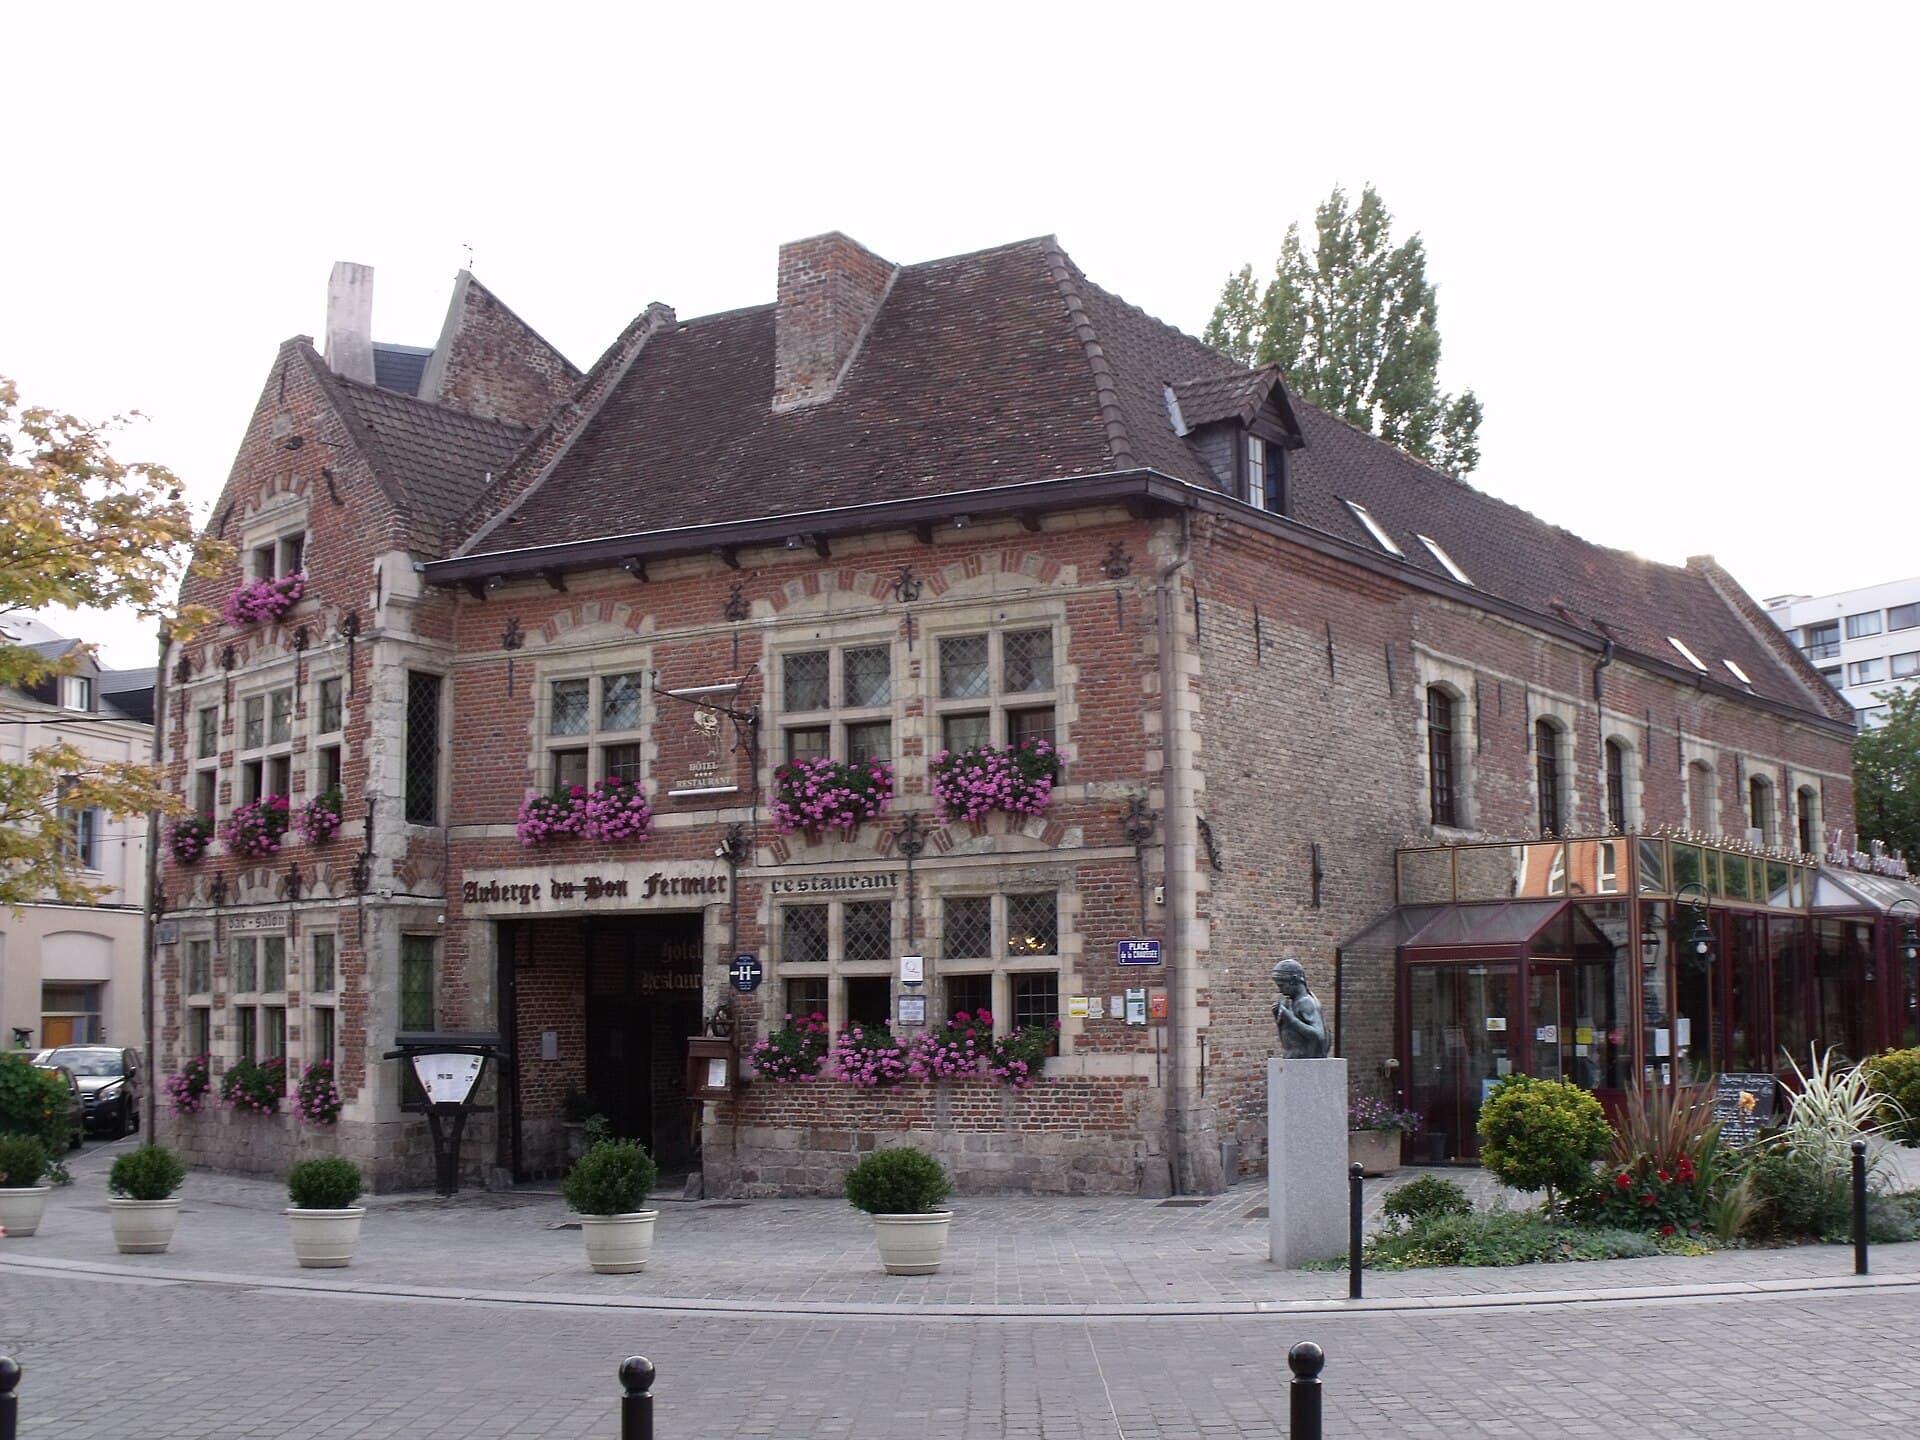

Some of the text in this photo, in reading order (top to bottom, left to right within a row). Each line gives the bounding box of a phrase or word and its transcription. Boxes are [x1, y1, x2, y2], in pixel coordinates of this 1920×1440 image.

[676, 776, 731, 788] RESTAURANT
[463, 872, 727, 905] Auberge du Bon Fermier
[771, 872, 898, 893] restaurant
[1128, 943, 1150, 951] PLACE
[739, 966, 751, 981] H
